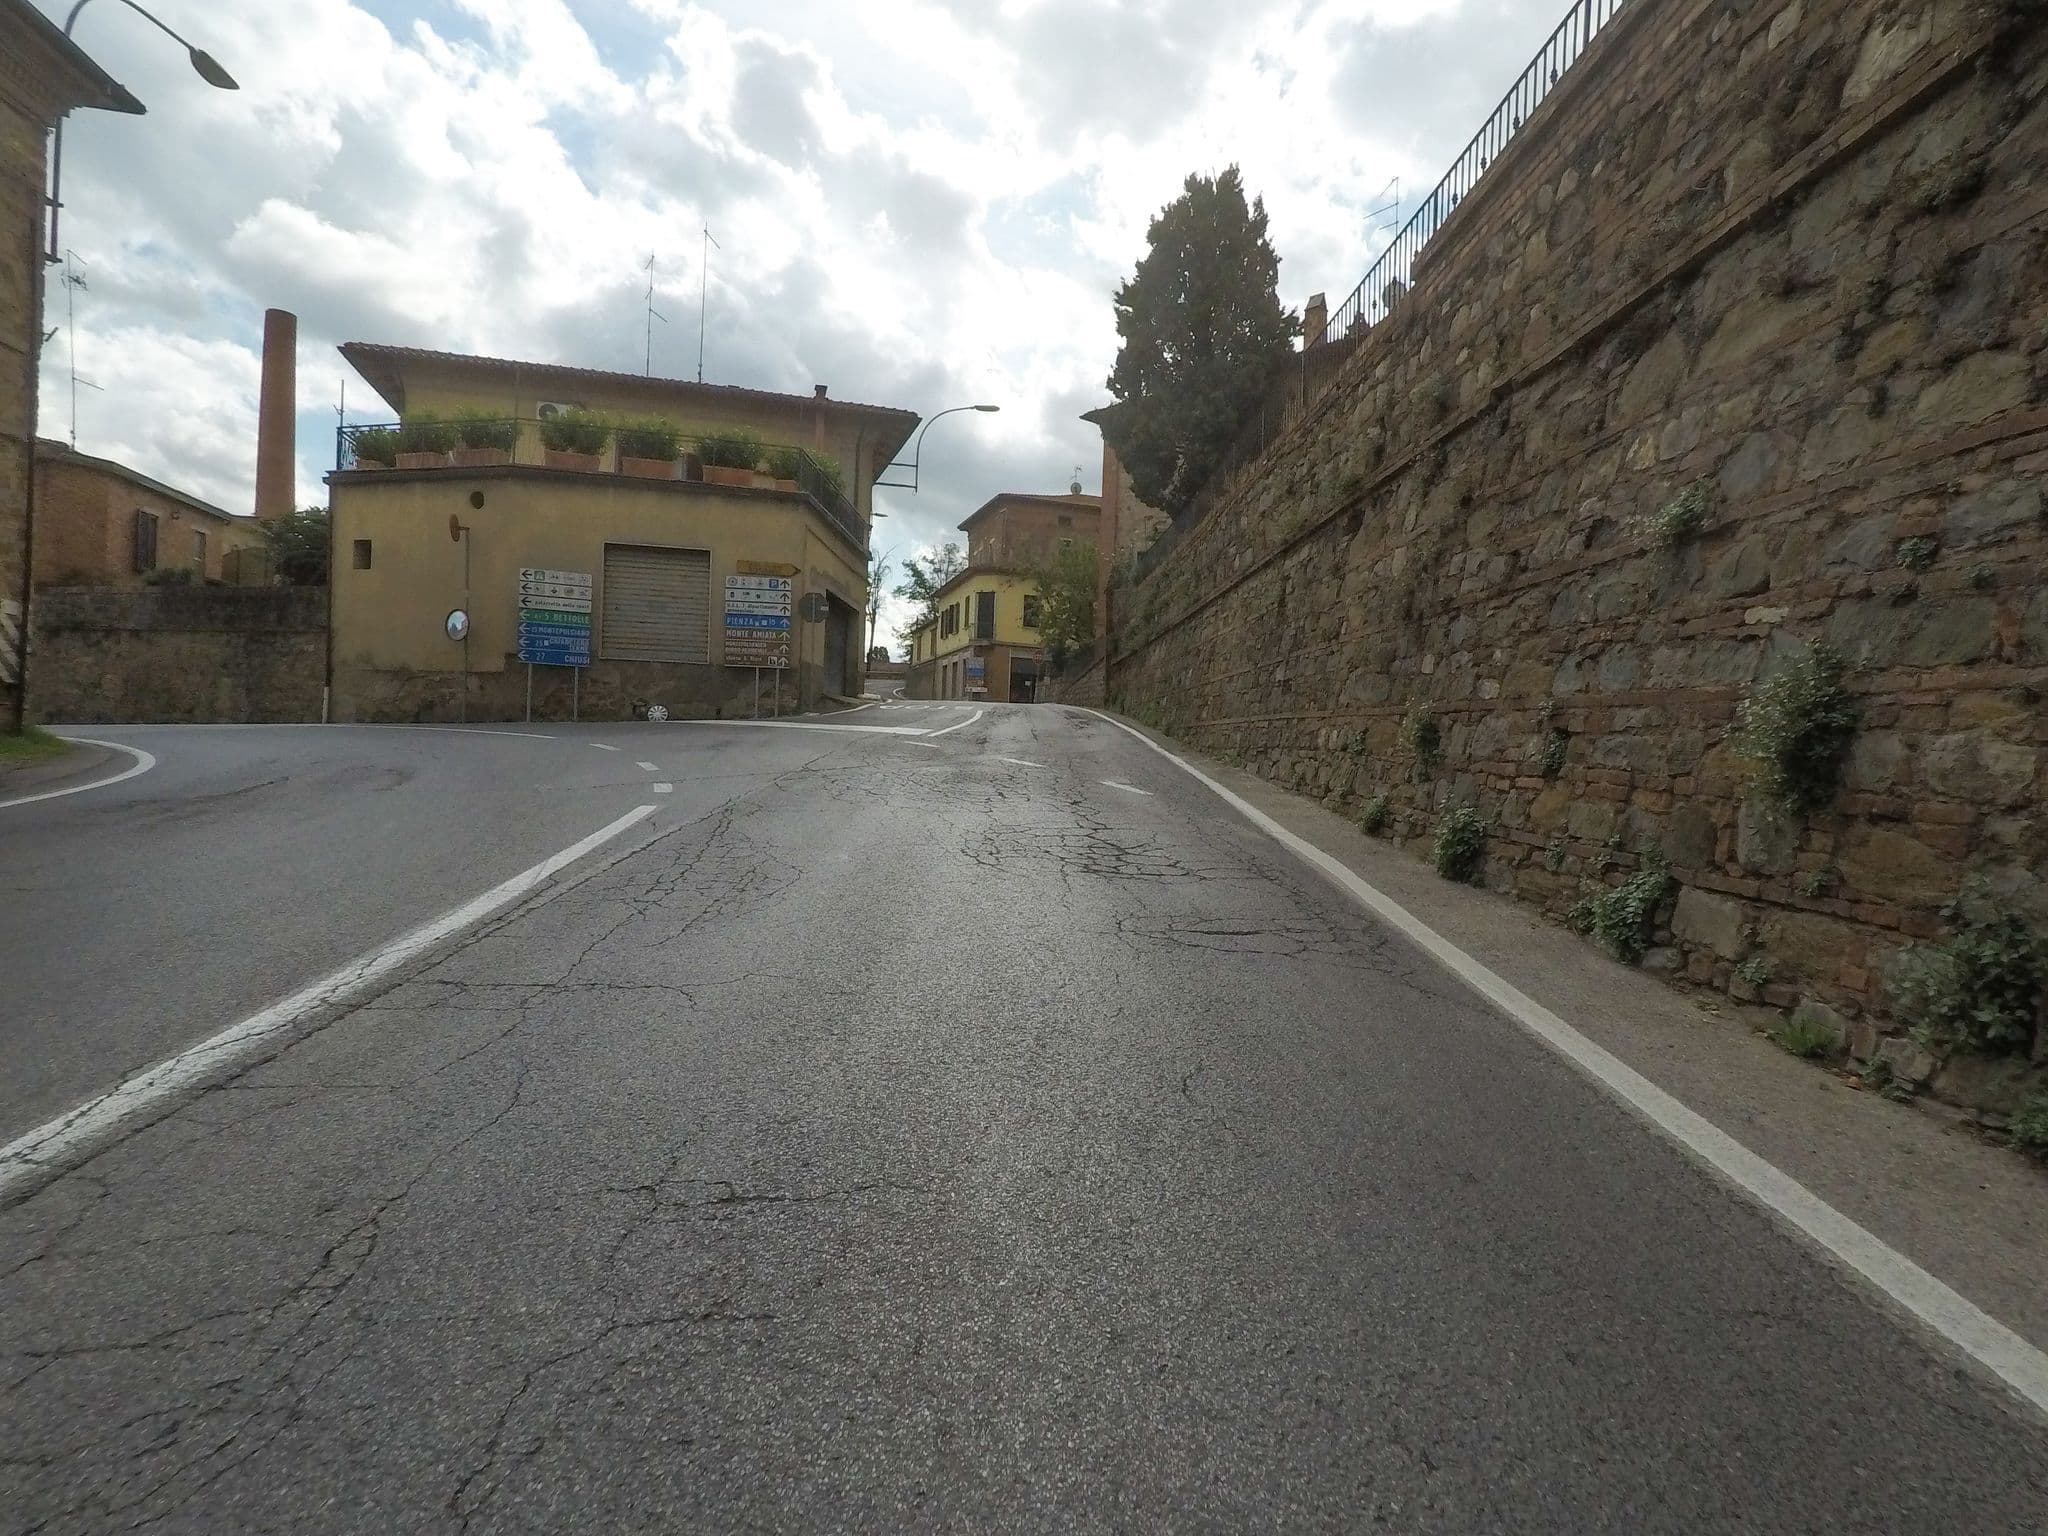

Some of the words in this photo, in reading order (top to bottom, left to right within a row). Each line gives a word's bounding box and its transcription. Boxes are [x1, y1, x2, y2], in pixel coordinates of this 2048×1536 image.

[553, 613, 590, 624] BETTOLLE
[726, 616, 753, 625] PIENZA
[726, 629, 749, 638] MONTE
[751, 631, 777, 639] AMIATA
[564, 655, 590, 665] CHIUSI
